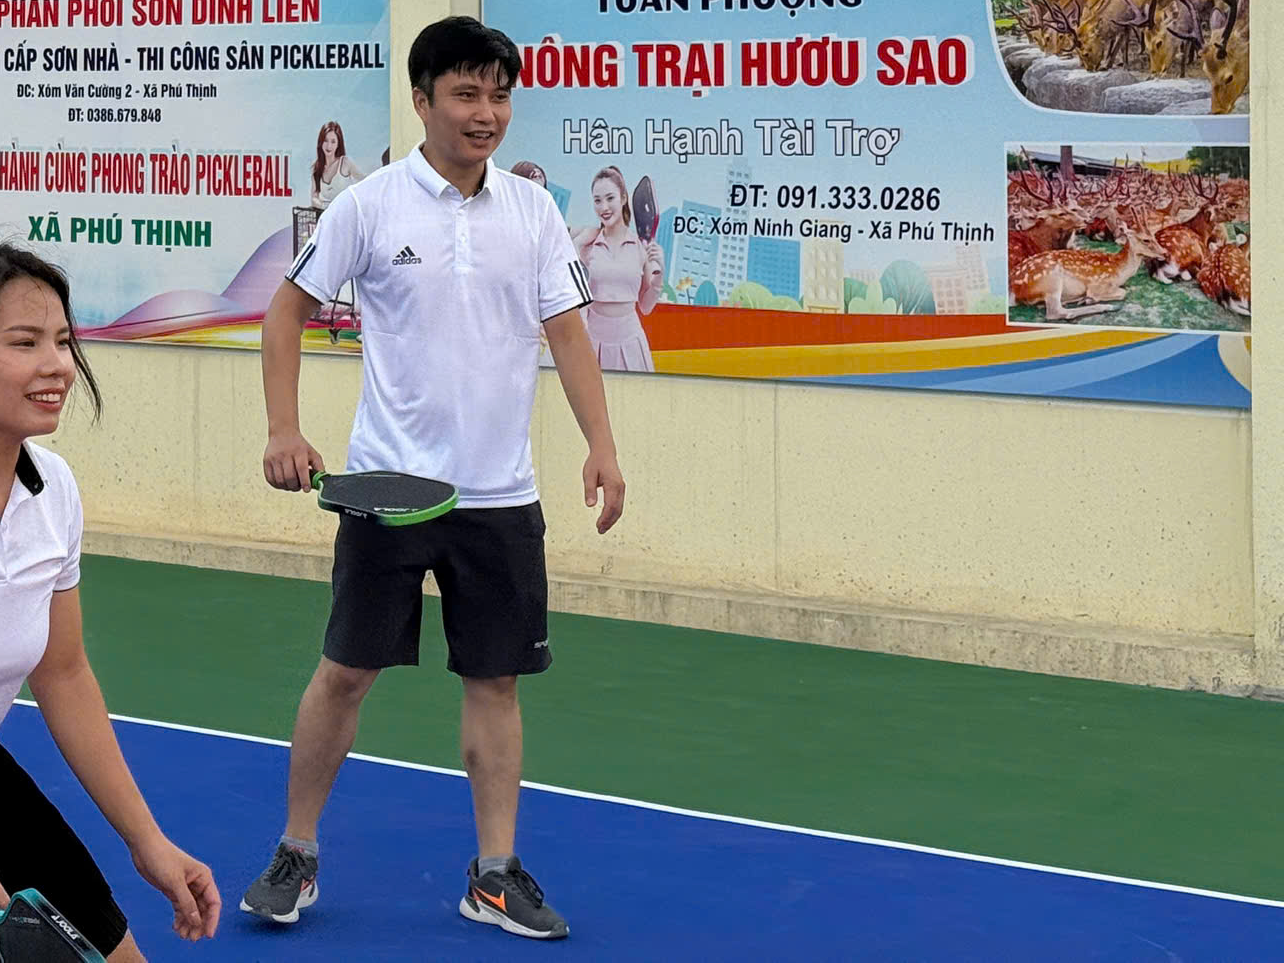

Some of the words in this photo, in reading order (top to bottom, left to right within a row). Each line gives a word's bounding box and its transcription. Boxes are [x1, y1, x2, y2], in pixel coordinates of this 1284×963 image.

[4, 40, 38, 72] CẤP
[42, 46, 78, 72] SƠN
[83, 43, 119, 72] NHÀ
[137, 47, 164, 71] THI
[170, 42, 220, 71] CÔNG
[225, 41, 264, 71] SÂN
[270, 43, 385, 70] PICKLEBALL
[632, 42, 725, 97] TRẠI
[741, 36, 859, 87] HƯƠU
[877, 38, 967, 87] SAO
[16, 85, 35, 98] ĐC:
[37, 84, 61, 98] Xóm
[64, 84, 85, 98] Văn
[87, 84, 122, 99] Cường
[125, 85, 132, 98] 2
[143, 83, 158, 98] Xã
[161, 83, 182, 98] Phú
[186, 83, 217, 101] Thịnh
[68, 108, 84, 122] ĐT:
[87, 108, 162, 123] 0386.679.848
[563, 118, 633, 155] Hân
[645, 118, 743, 163] Hạnh
[754, 118, 814, 156] Tài
[826, 119, 900, 165] Trợ
[0, 142, 40, 192] HÀNH
[44, 142, 86, 193] CÙNG
[91, 152, 145, 194] PHONG
[149, 145, 190, 195] TRÀO
[196, 153, 293, 197] PICKLEBALL
[730, 184, 768, 208] ĐT:
[776, 186, 941, 211] 091.333.0286
[27, 211, 62, 242] XÃ
[71, 213, 122, 244] PHÚ
[132, 219, 212, 252] THỊNH
[673, 216, 704, 235] ĐC:
[709, 217, 748, 236] Xóm
[754, 218, 793, 237] Ninh
[799, 220, 852, 243] Giang
[869, 221, 892, 239] Xã
[899, 221, 934, 240] Phú
[941, 222, 995, 246] Thịnh
[391, 257, 422, 266] adidas
